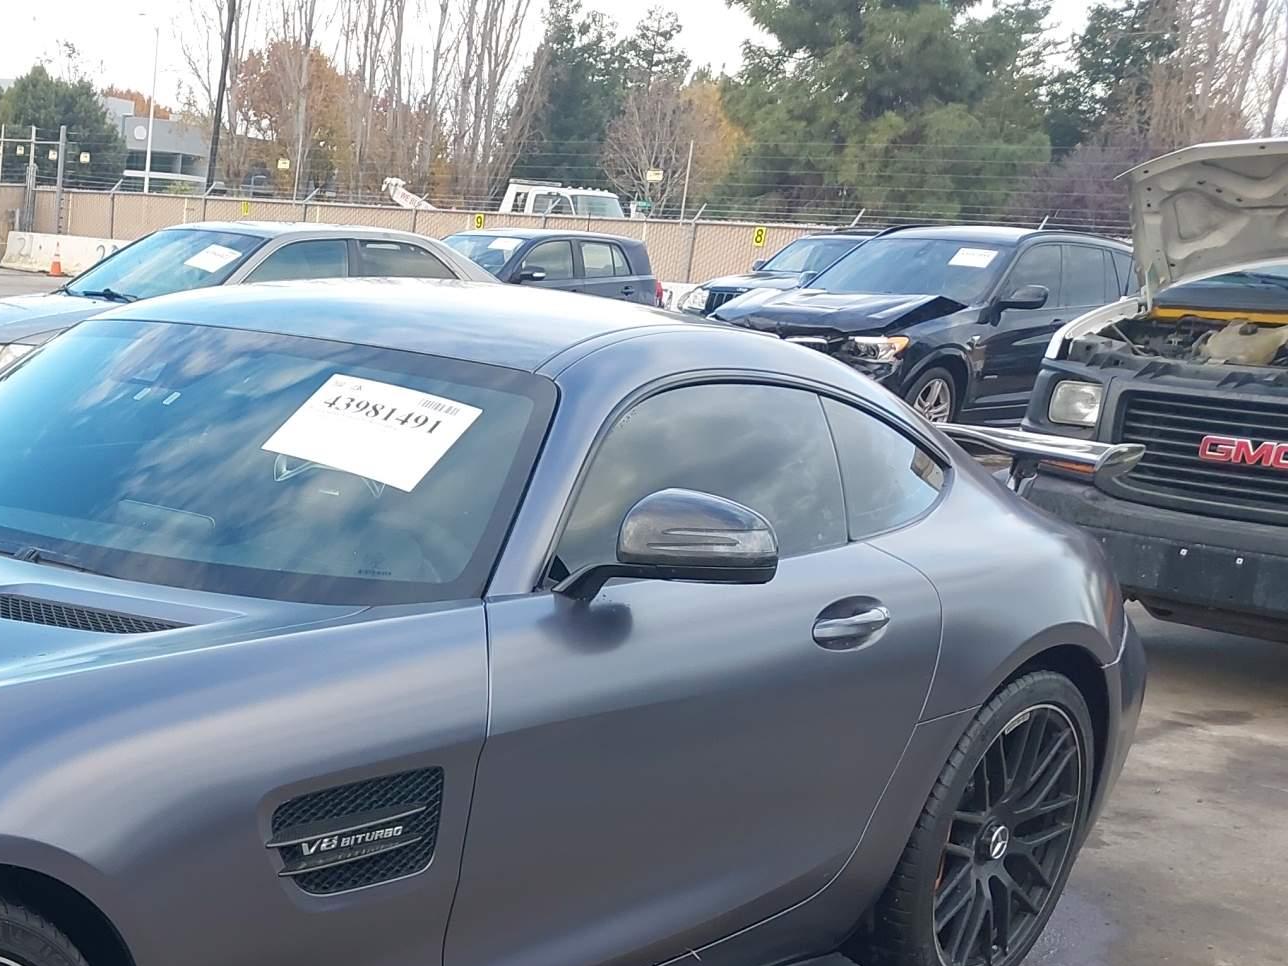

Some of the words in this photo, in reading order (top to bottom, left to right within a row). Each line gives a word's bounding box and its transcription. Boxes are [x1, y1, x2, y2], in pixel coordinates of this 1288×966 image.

[475, 215, 483, 229] 9
[754, 228, 764, 244] 8
[323, 395, 443, 434] 43981491
[301, 835, 339, 856] V8
[340, 825, 404, 848] BITURBO
